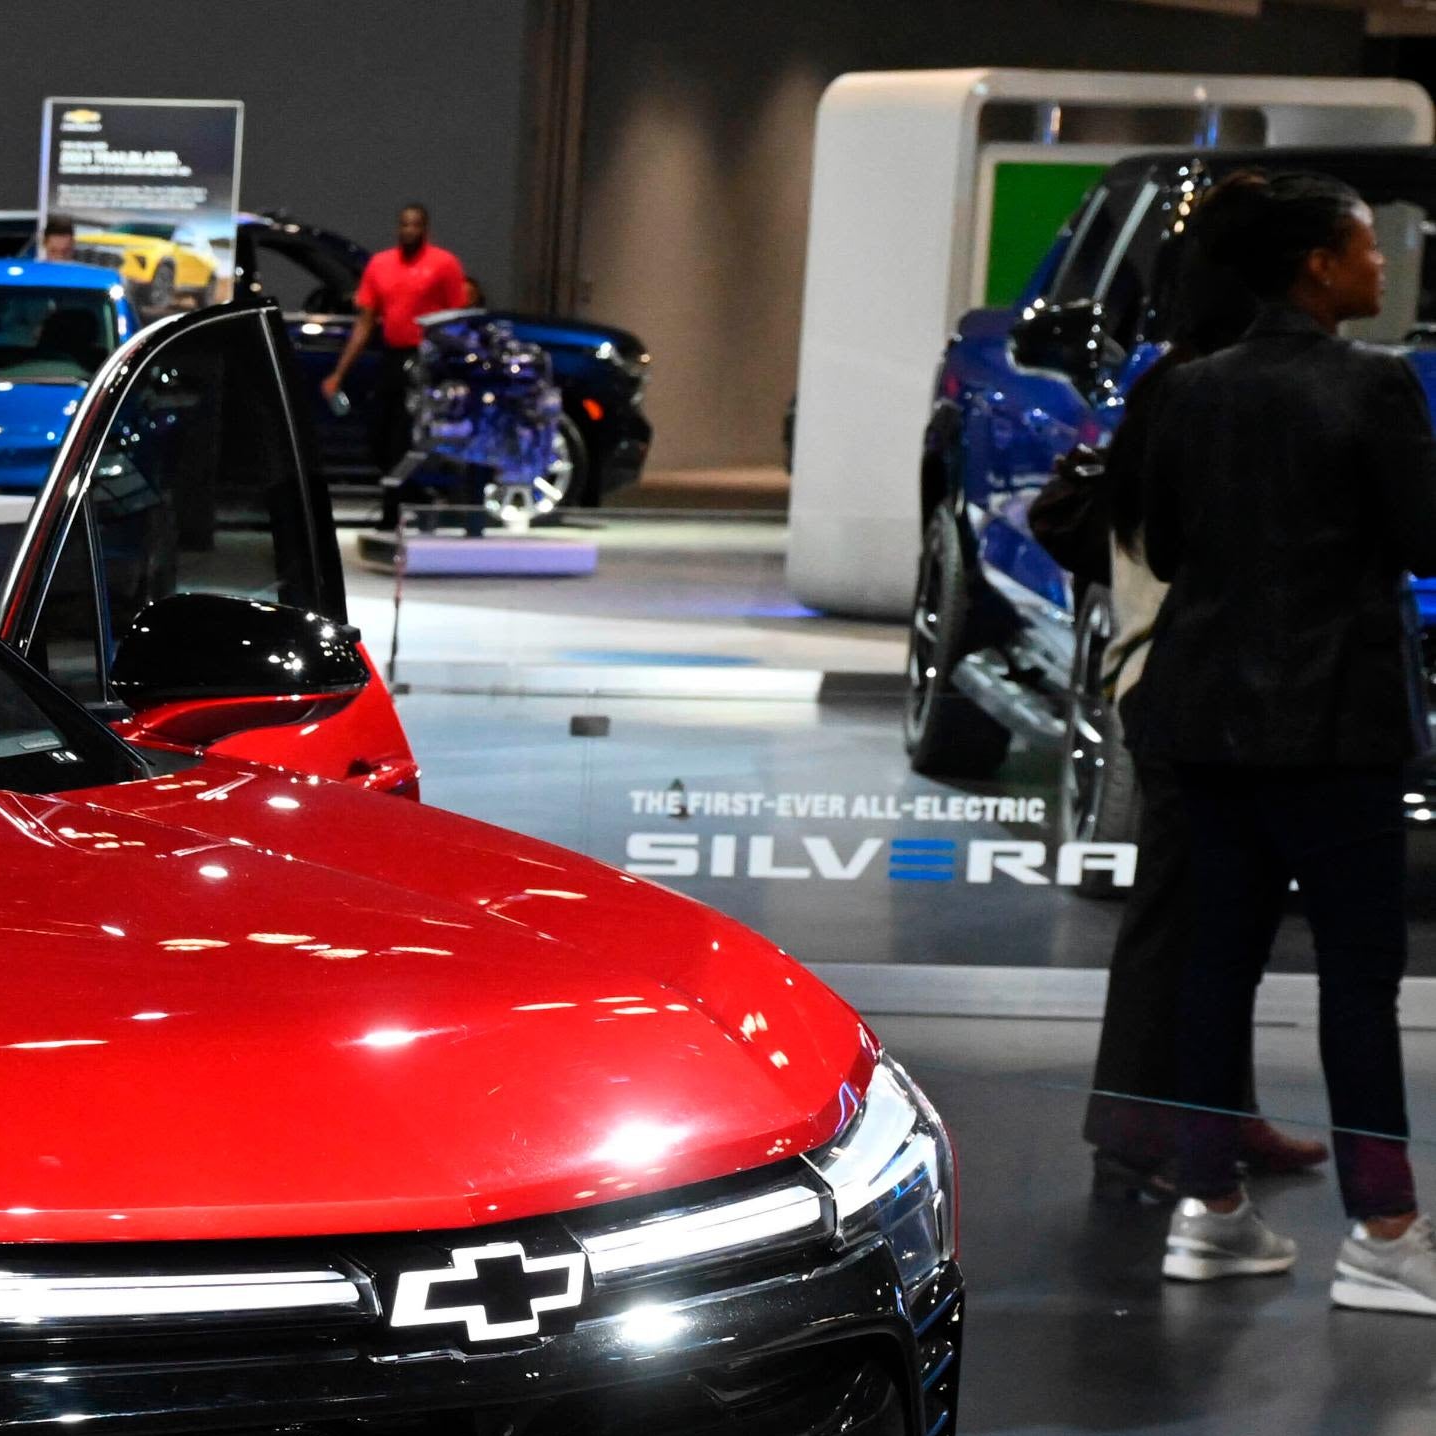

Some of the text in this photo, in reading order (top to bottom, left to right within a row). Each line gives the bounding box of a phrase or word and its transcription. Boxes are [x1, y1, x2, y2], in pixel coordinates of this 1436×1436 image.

[629, 790, 1045, 822] THE FIRST-EVER ALL-ELECTRIC
[625, 832, 1139, 886] SILVERA
